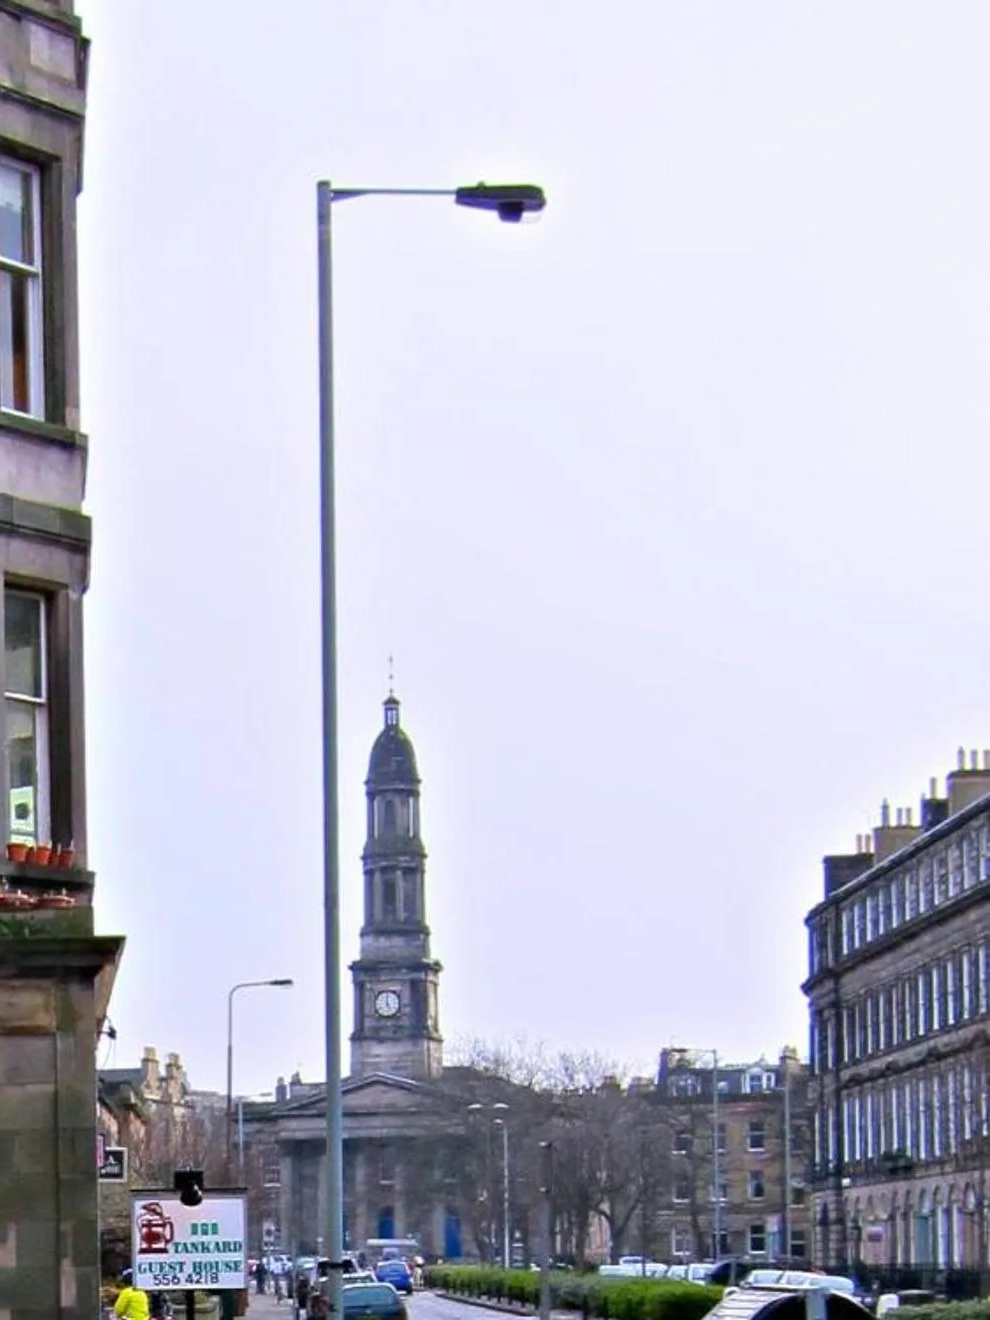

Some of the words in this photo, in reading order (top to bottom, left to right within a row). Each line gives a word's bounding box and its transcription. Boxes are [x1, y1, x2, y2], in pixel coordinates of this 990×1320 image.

[173, 1241, 242, 1254] TANKARD
[138, 1261, 186, 1274] GUEST
[192, 1260, 242, 1273] HOUSE
[153, 1273, 181, 1286] 556
